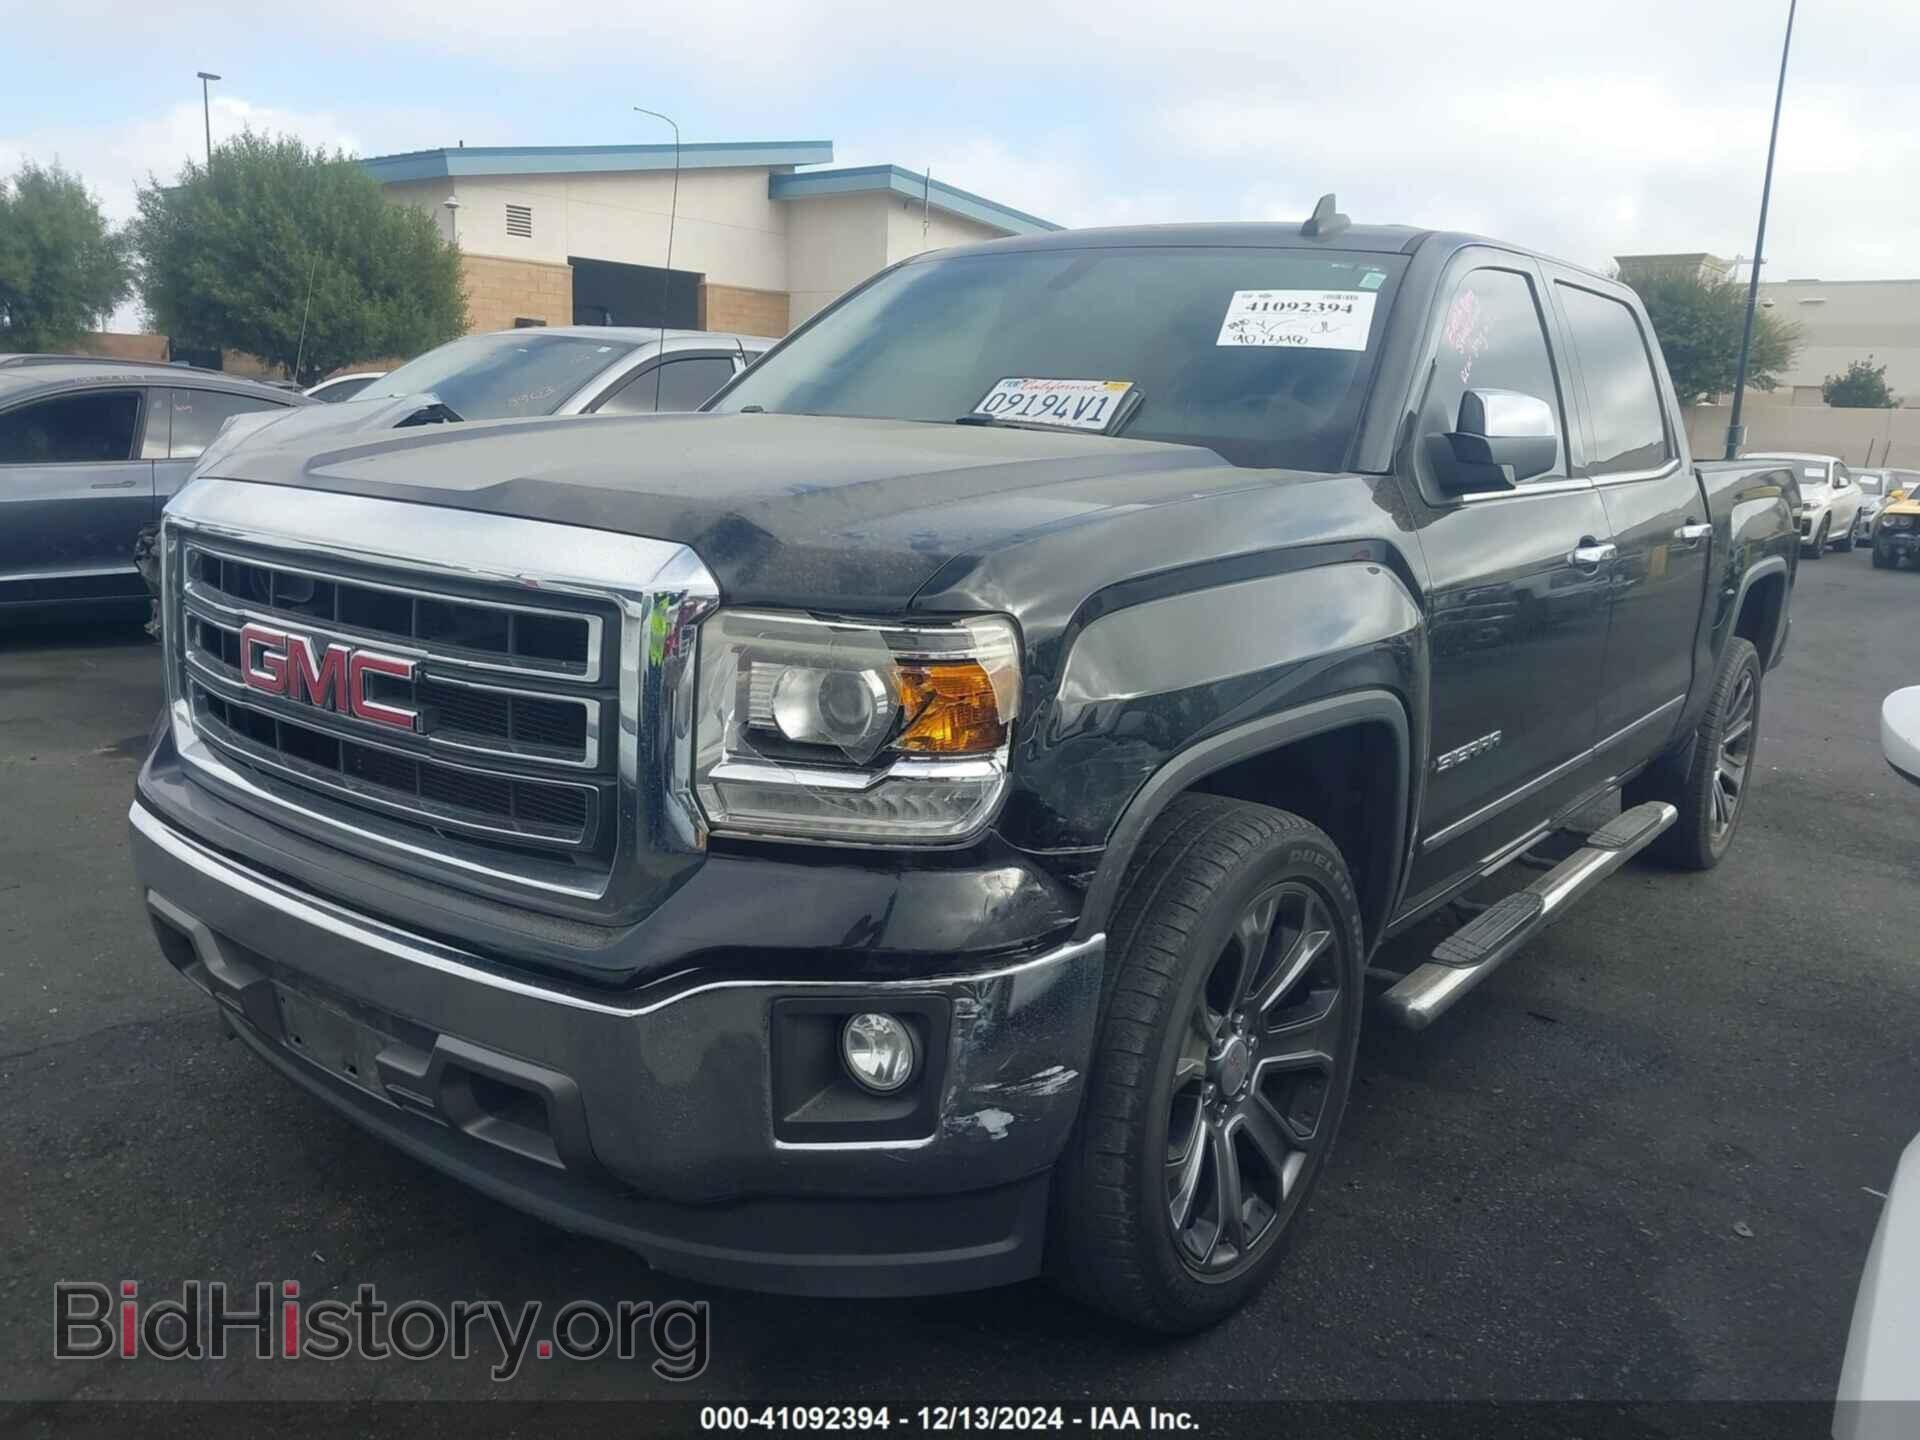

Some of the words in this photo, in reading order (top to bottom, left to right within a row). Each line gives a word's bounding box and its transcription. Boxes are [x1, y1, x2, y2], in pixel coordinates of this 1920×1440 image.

[1245, 301, 1353, 314] 41092394
[1021, 378, 1099, 393] California
[983, 392, 1110, 422] 09194V1
[240, 622, 420, 733] GMC
